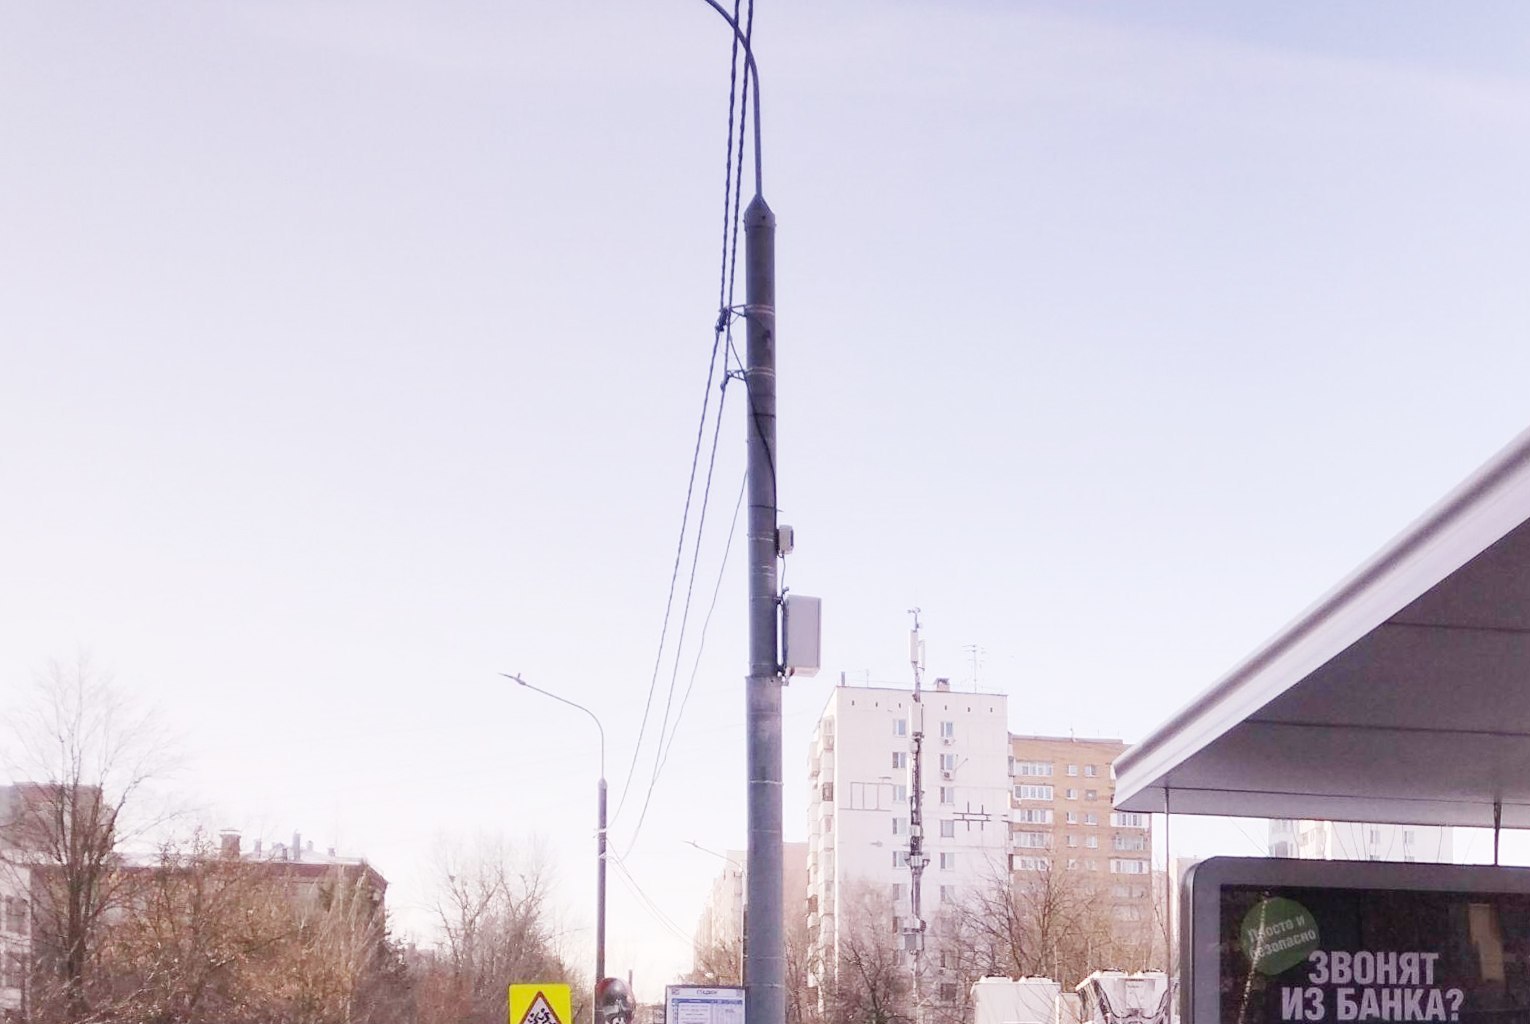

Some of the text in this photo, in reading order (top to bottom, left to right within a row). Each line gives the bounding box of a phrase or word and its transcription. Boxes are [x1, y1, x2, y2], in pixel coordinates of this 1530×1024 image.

[1308, 950, 1440, 985] ЗВОНЯТ
[1281, 986, 1465, 1022] ИЗ БАНКА?
